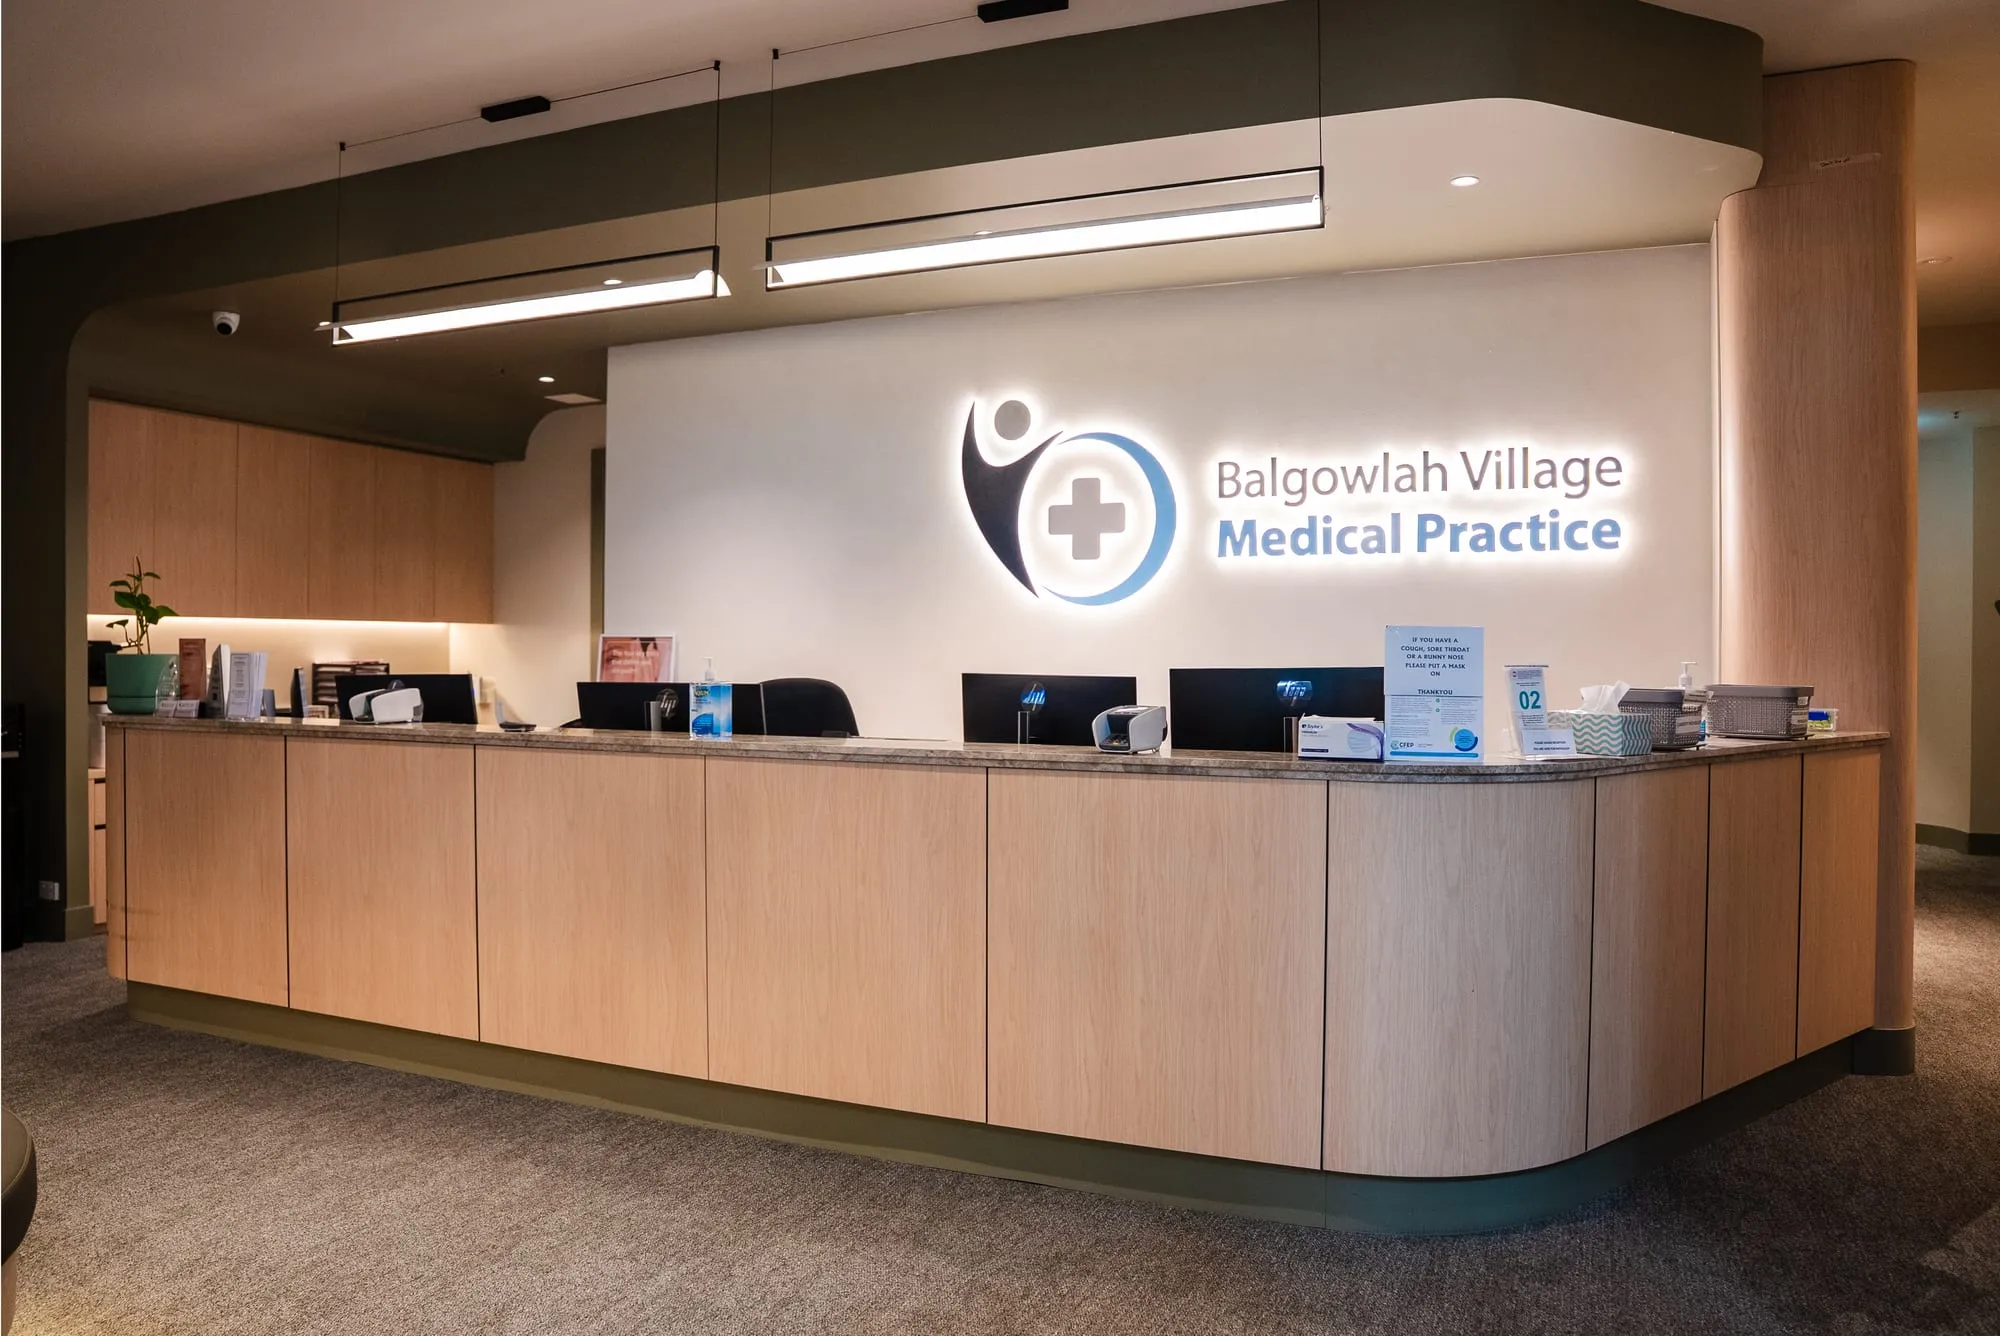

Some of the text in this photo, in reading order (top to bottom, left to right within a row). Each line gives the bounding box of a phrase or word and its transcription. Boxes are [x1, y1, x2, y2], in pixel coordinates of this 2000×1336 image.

[1218, 447, 1622, 507] Balgowlah Village
[1218, 508, 1621, 557] Medical Practice
[660, 691, 677, 717] hp
[1519, 690, 1541, 710] 02
